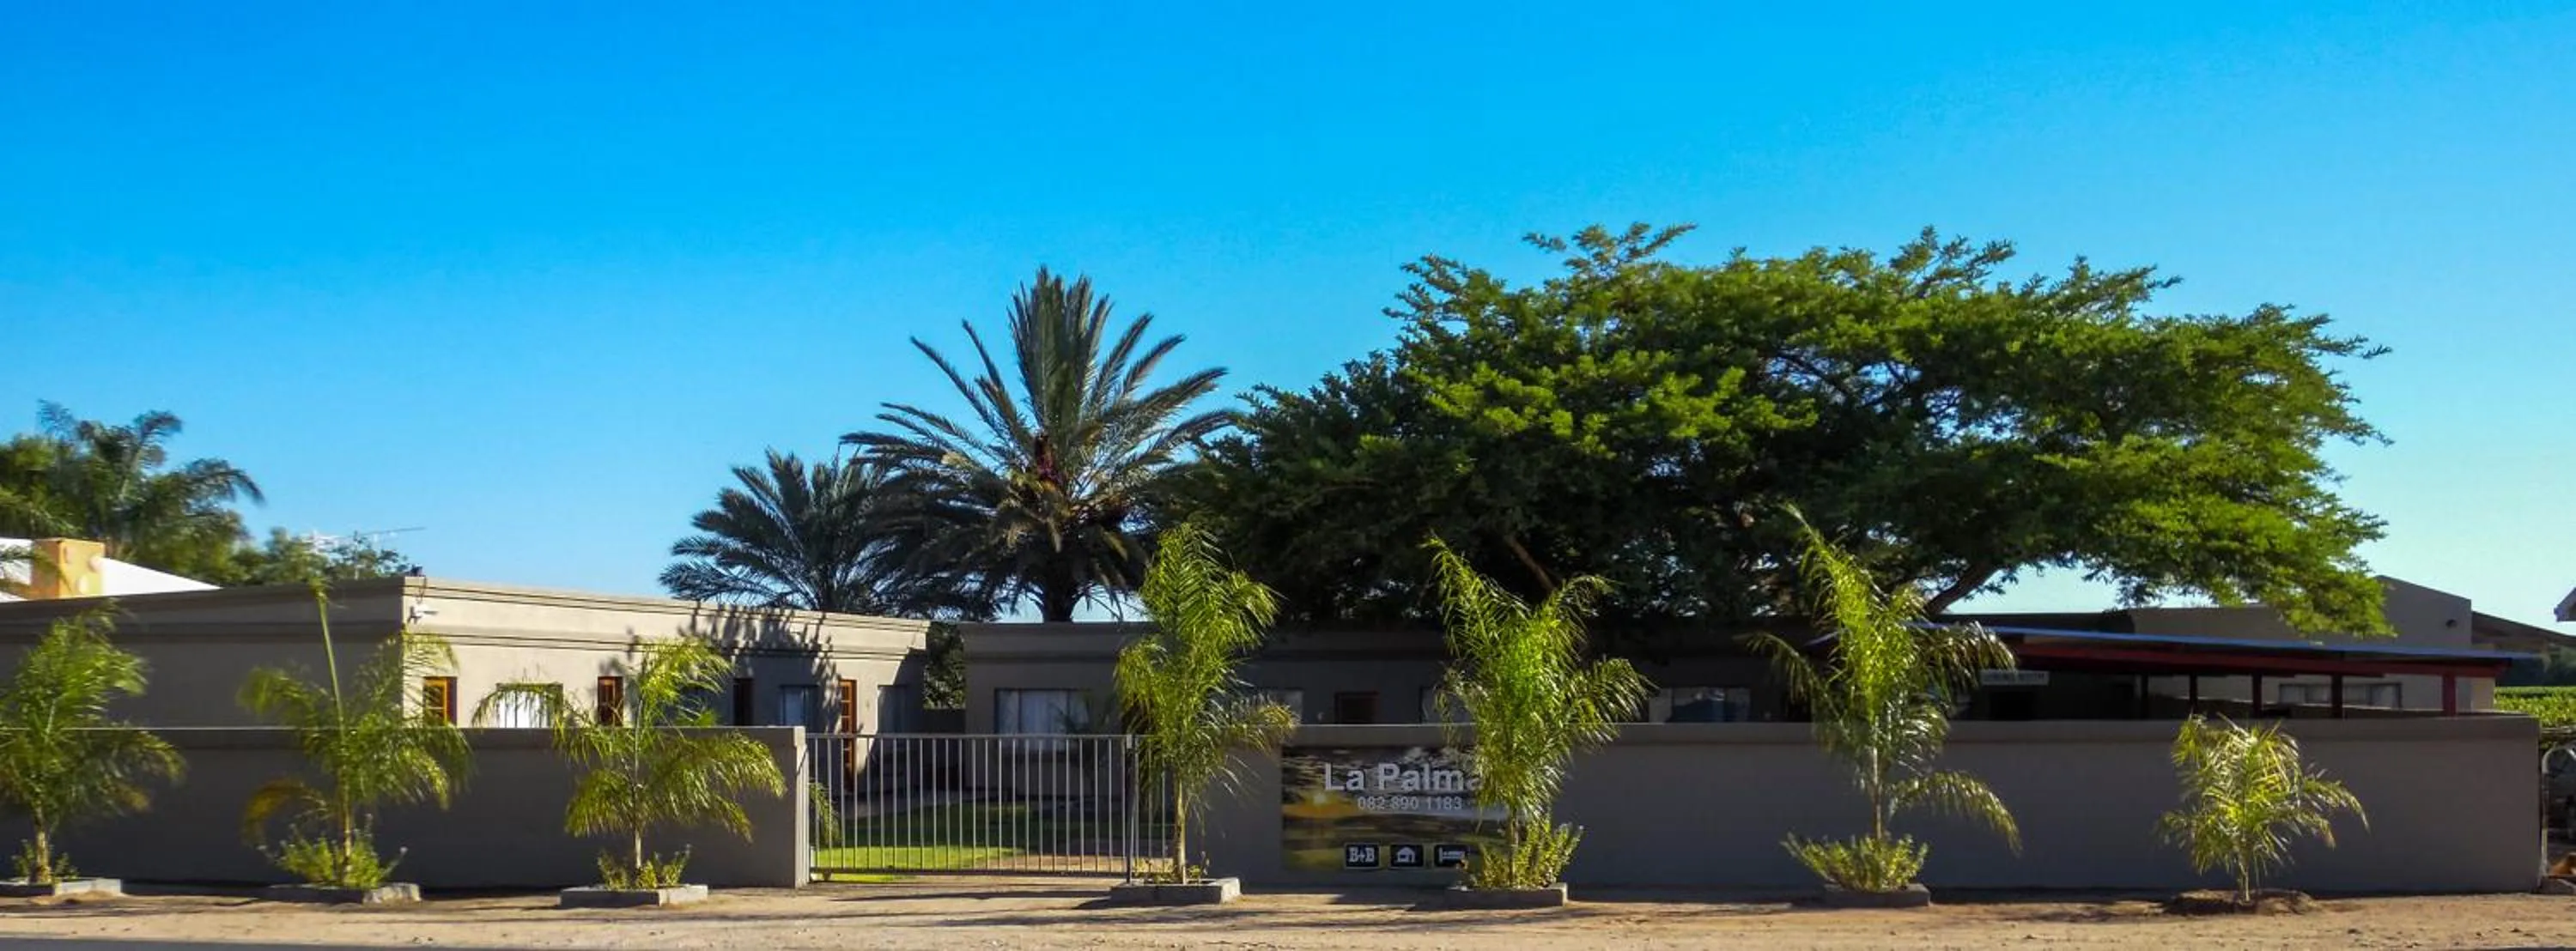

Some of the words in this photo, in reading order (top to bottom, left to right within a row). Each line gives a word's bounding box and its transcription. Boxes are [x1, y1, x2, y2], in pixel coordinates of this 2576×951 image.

[1324, 762, 1365, 790] La
[1358, 796, 1385, 810] 082
[1391, 796, 1419, 810] 890
[1426, 796, 1462, 810] 1183
